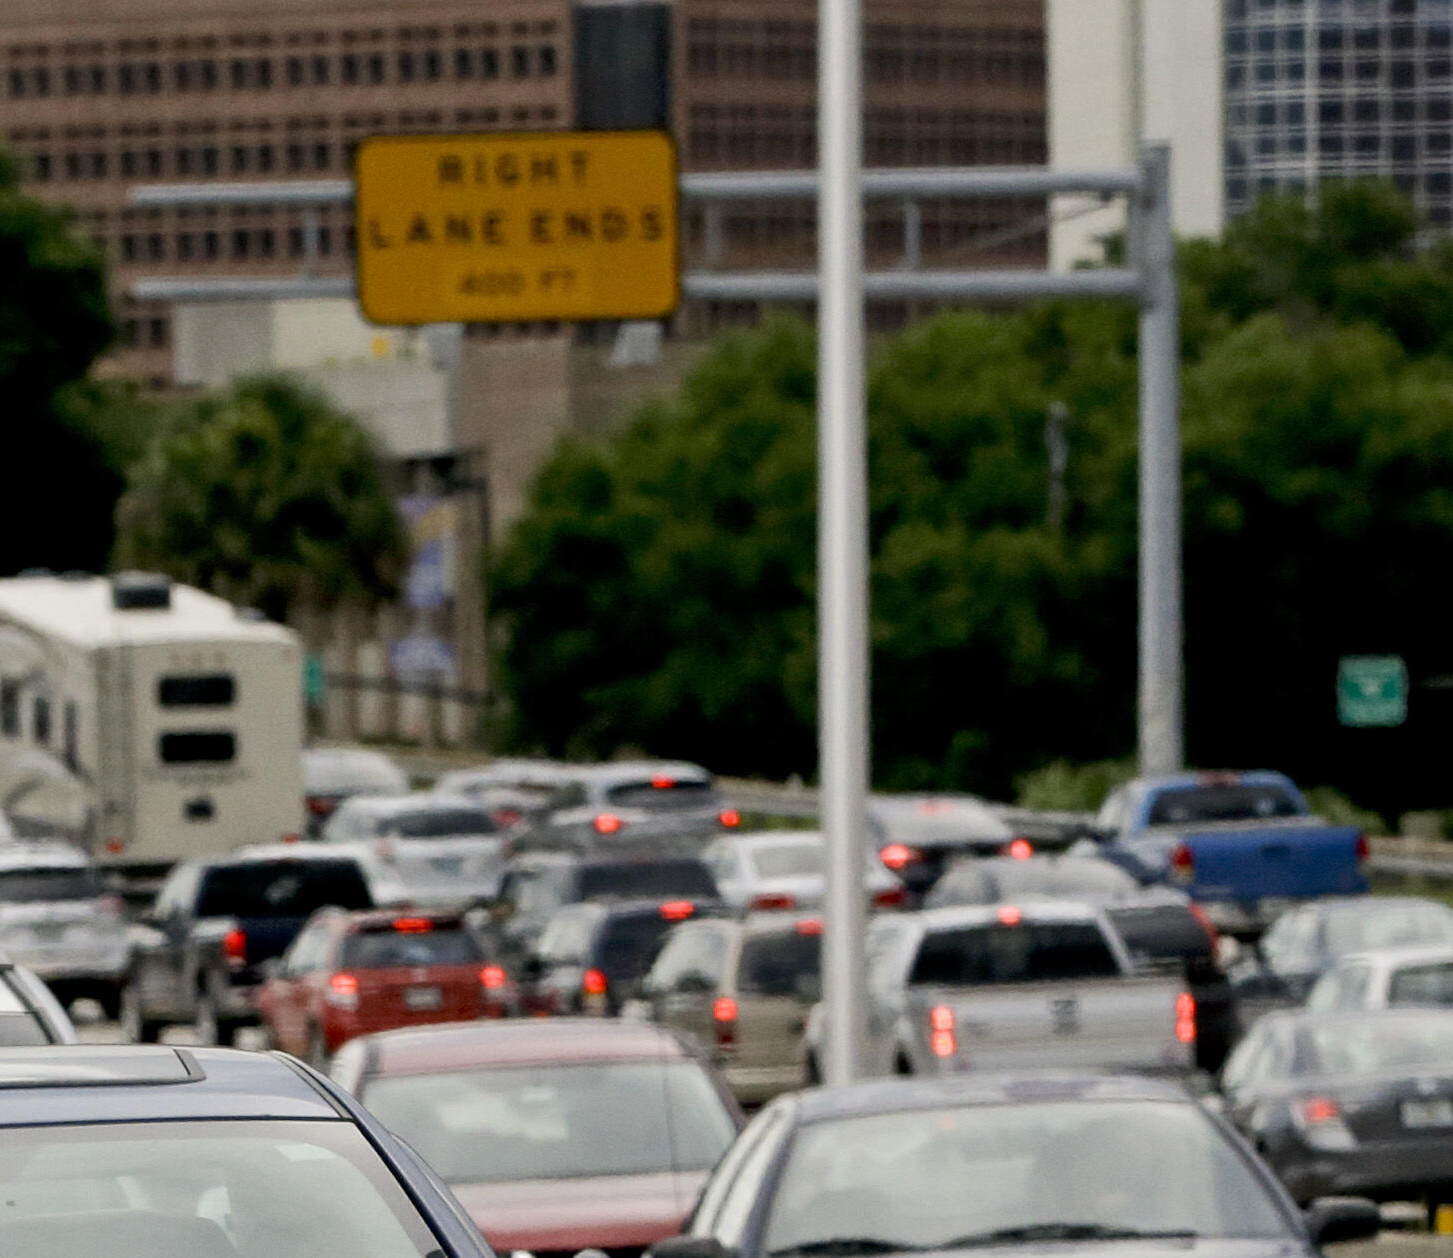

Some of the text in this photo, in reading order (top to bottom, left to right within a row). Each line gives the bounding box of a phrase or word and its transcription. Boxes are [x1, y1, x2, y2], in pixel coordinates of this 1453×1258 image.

[437, 150, 587, 187] RIGHT
[366, 205, 663, 249] LANE ENDS
[539, 267, 577, 292] FT
